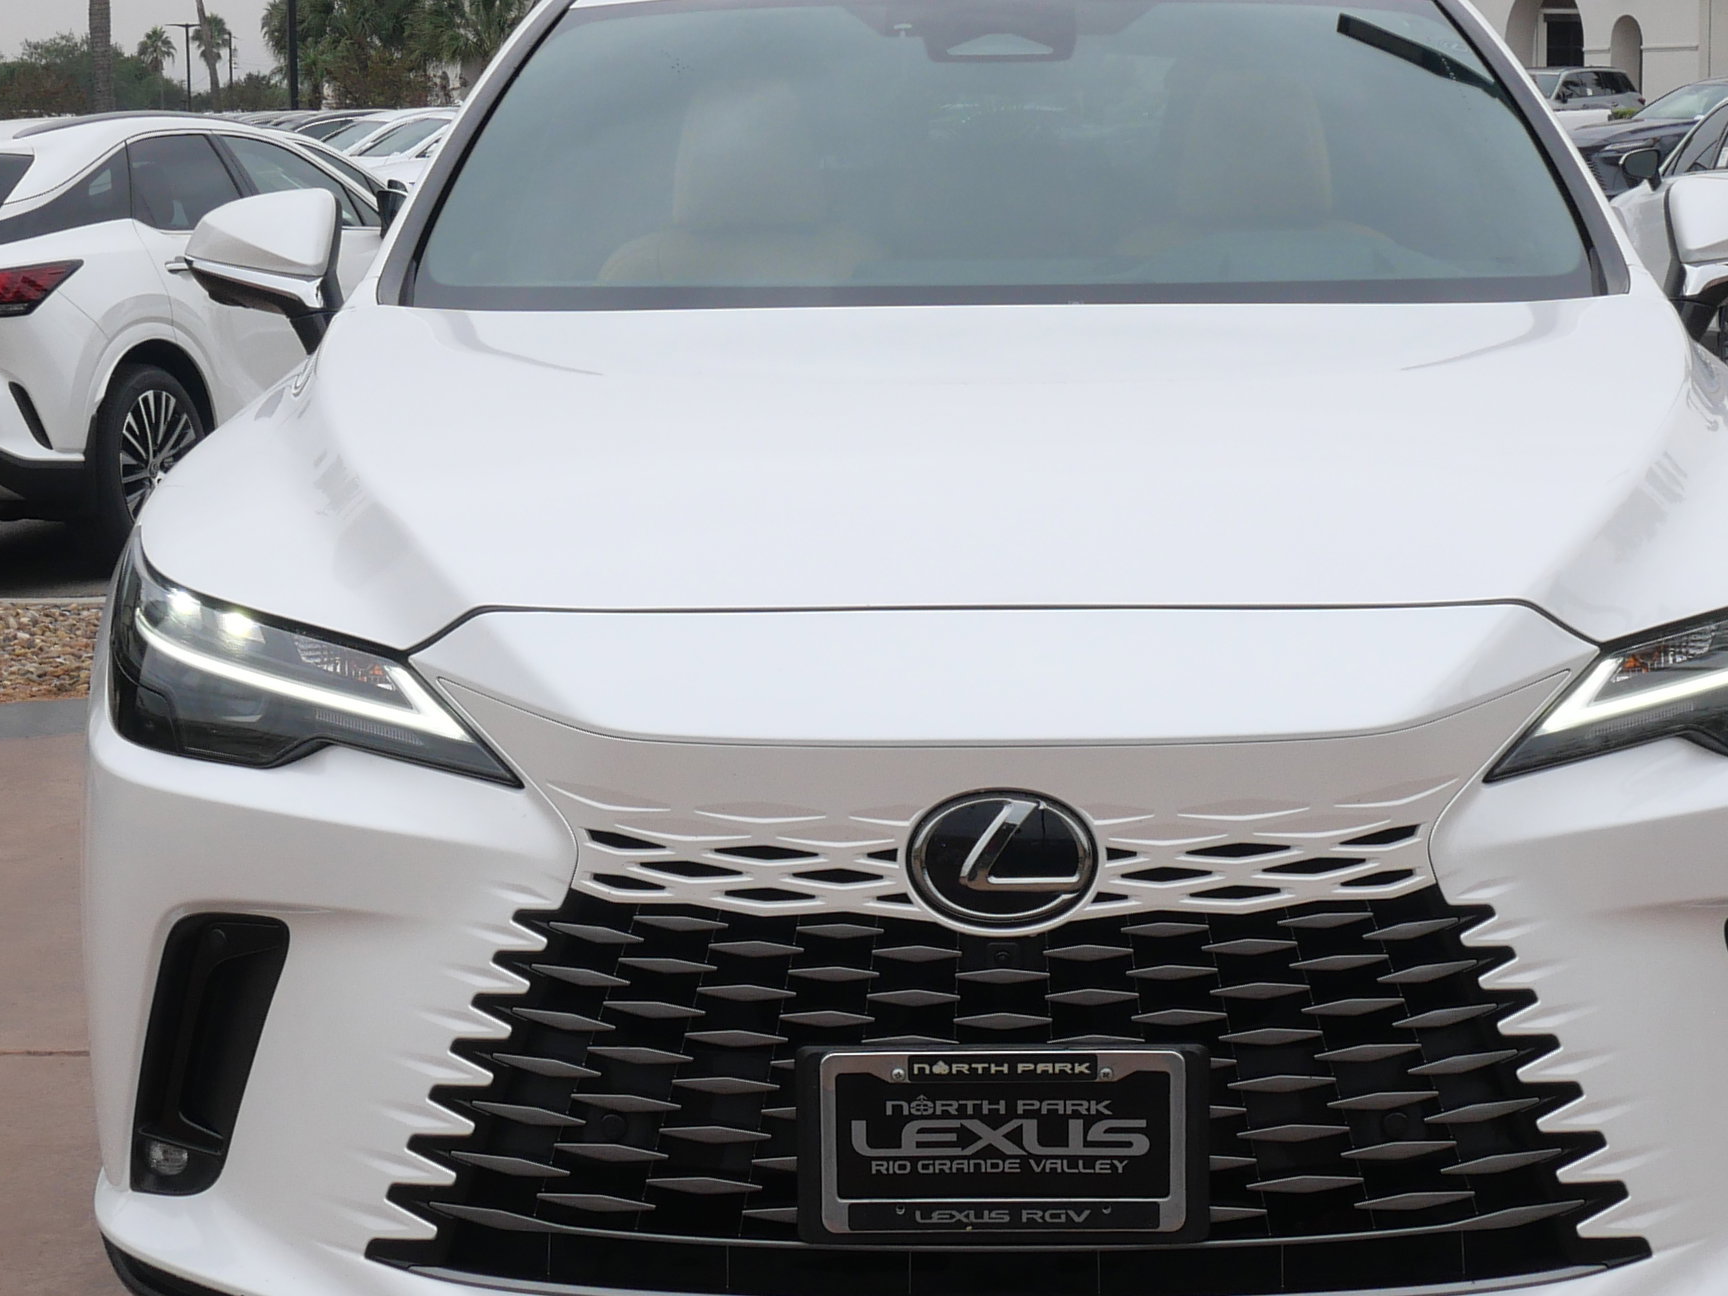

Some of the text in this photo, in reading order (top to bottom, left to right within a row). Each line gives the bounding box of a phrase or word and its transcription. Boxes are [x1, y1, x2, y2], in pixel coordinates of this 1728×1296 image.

[913, 1060, 1091, 1075] NORTH PARK
[886, 1096, 1112, 1116] NORTH PARK
[851, 1119, 1150, 1156] LEXUS
[872, 1159, 1128, 1174] RIO GRANDE VALLEY
[915, 1209, 1091, 1223] LEXUS RGV
